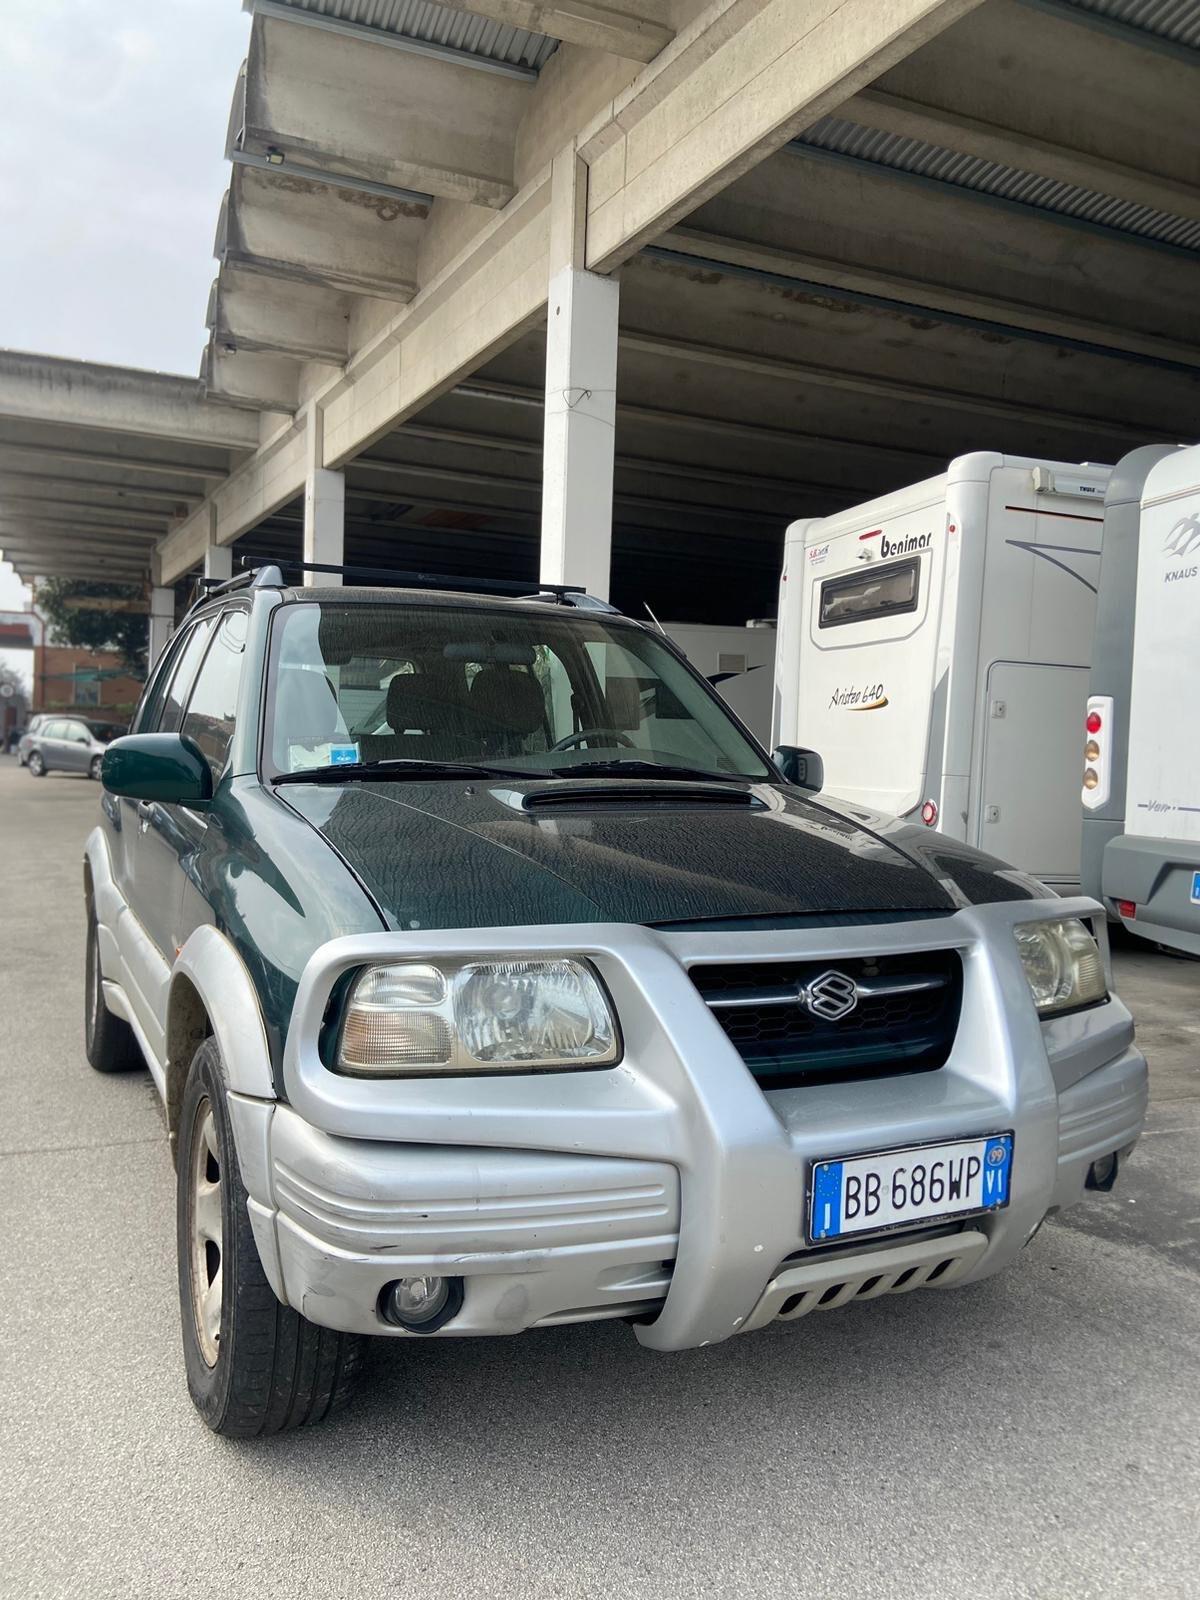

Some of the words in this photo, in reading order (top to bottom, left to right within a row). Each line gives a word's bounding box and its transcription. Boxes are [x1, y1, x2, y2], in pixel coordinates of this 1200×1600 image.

[881, 532, 932, 558] benimar
[1164, 566, 1198, 583] KNAUS
[862, 683, 884, 703] 640
[990, 1149, 1003, 1163] 99
[845, 1172, 881, 1220] BB
[892, 1156, 981, 1210] 686WP
[986, 1169, 1003, 1194] VI
